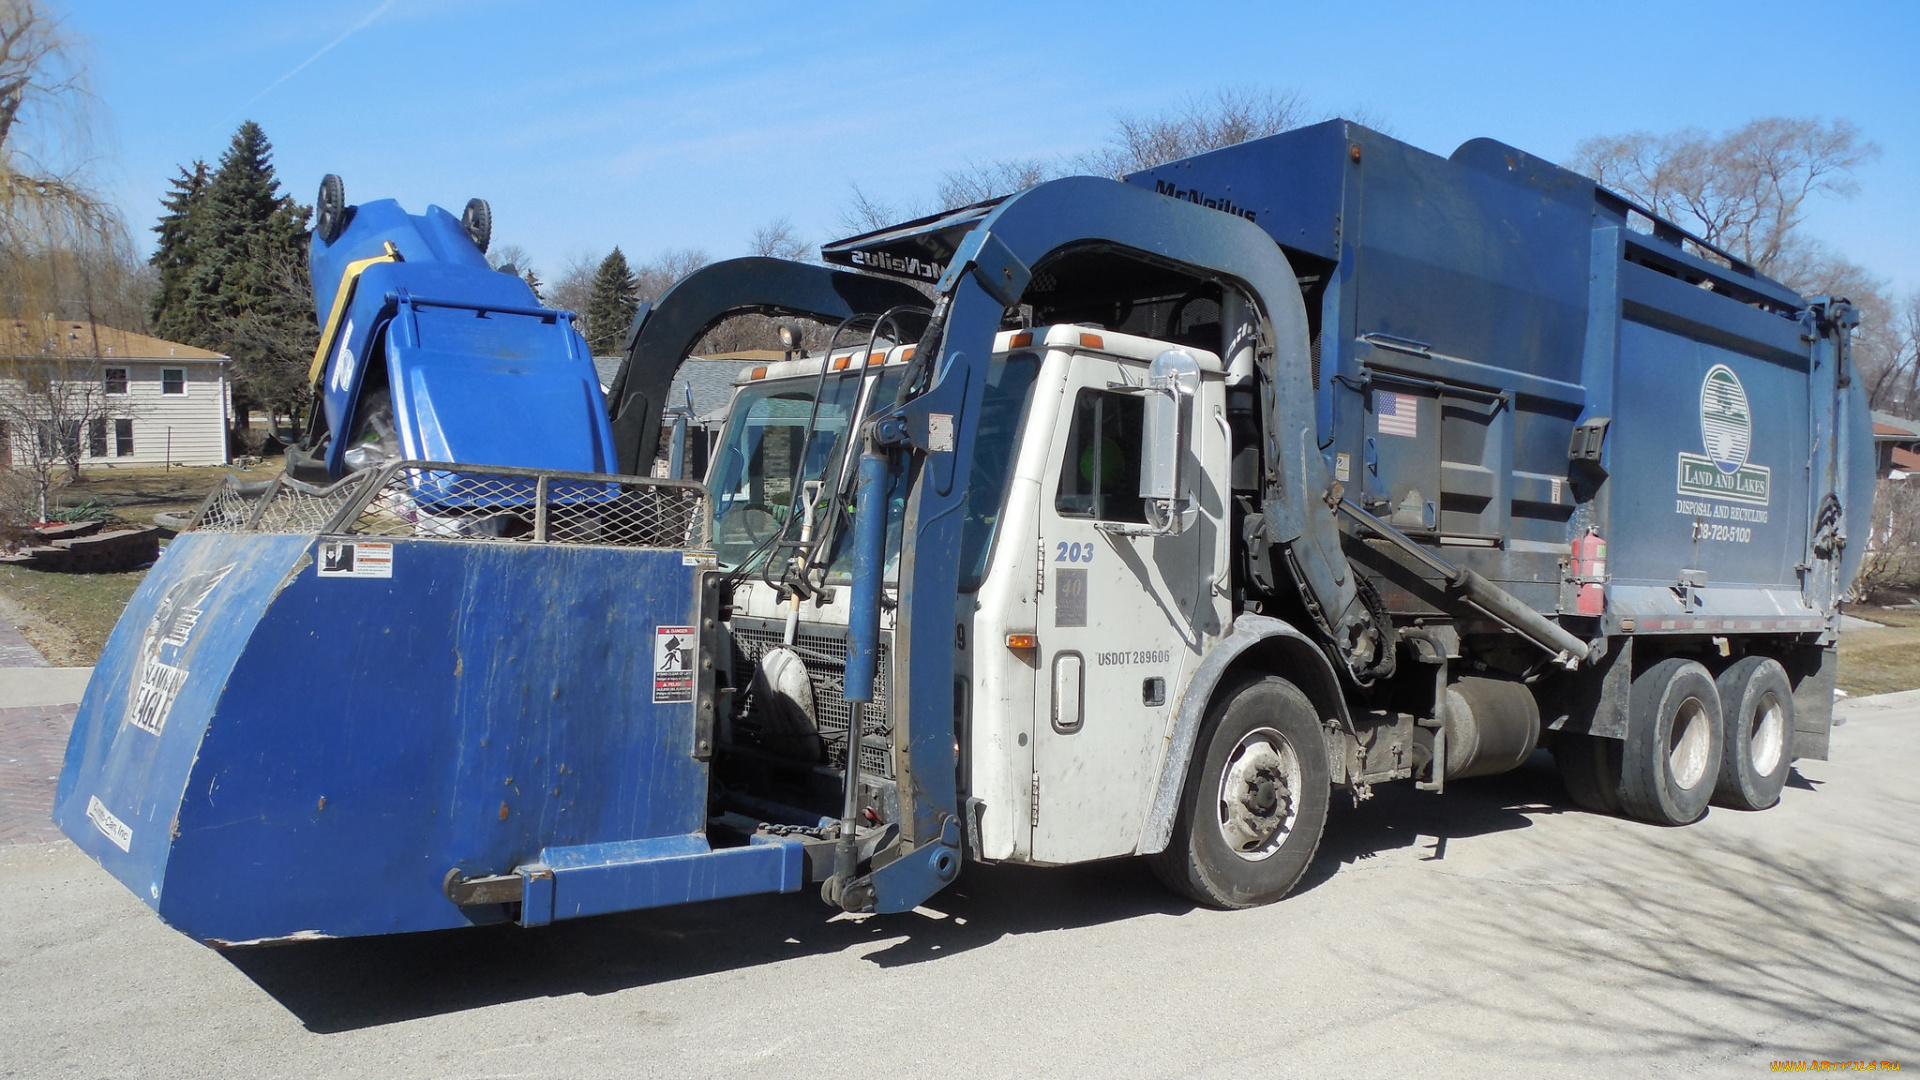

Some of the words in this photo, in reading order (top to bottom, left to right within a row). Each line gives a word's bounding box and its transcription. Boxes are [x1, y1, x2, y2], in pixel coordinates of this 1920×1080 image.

[1684, 464, 1713, 487] LAND
[1714, 473, 1734, 490] AND
[1736, 473, 1765, 495] LAKES
[1676, 500, 1712, 518] DISPOSAL
[1713, 504, 1730, 519] AND
[1730, 507, 1768, 524] RECYCLING
[1054, 541, 1094, 563] 203
[1062, 578, 1082, 597] 40
[1098, 651, 1132, 666] USDOT
[1133, 650, 1170, 664] 289606
[131, 686, 173, 731] EAGLE
